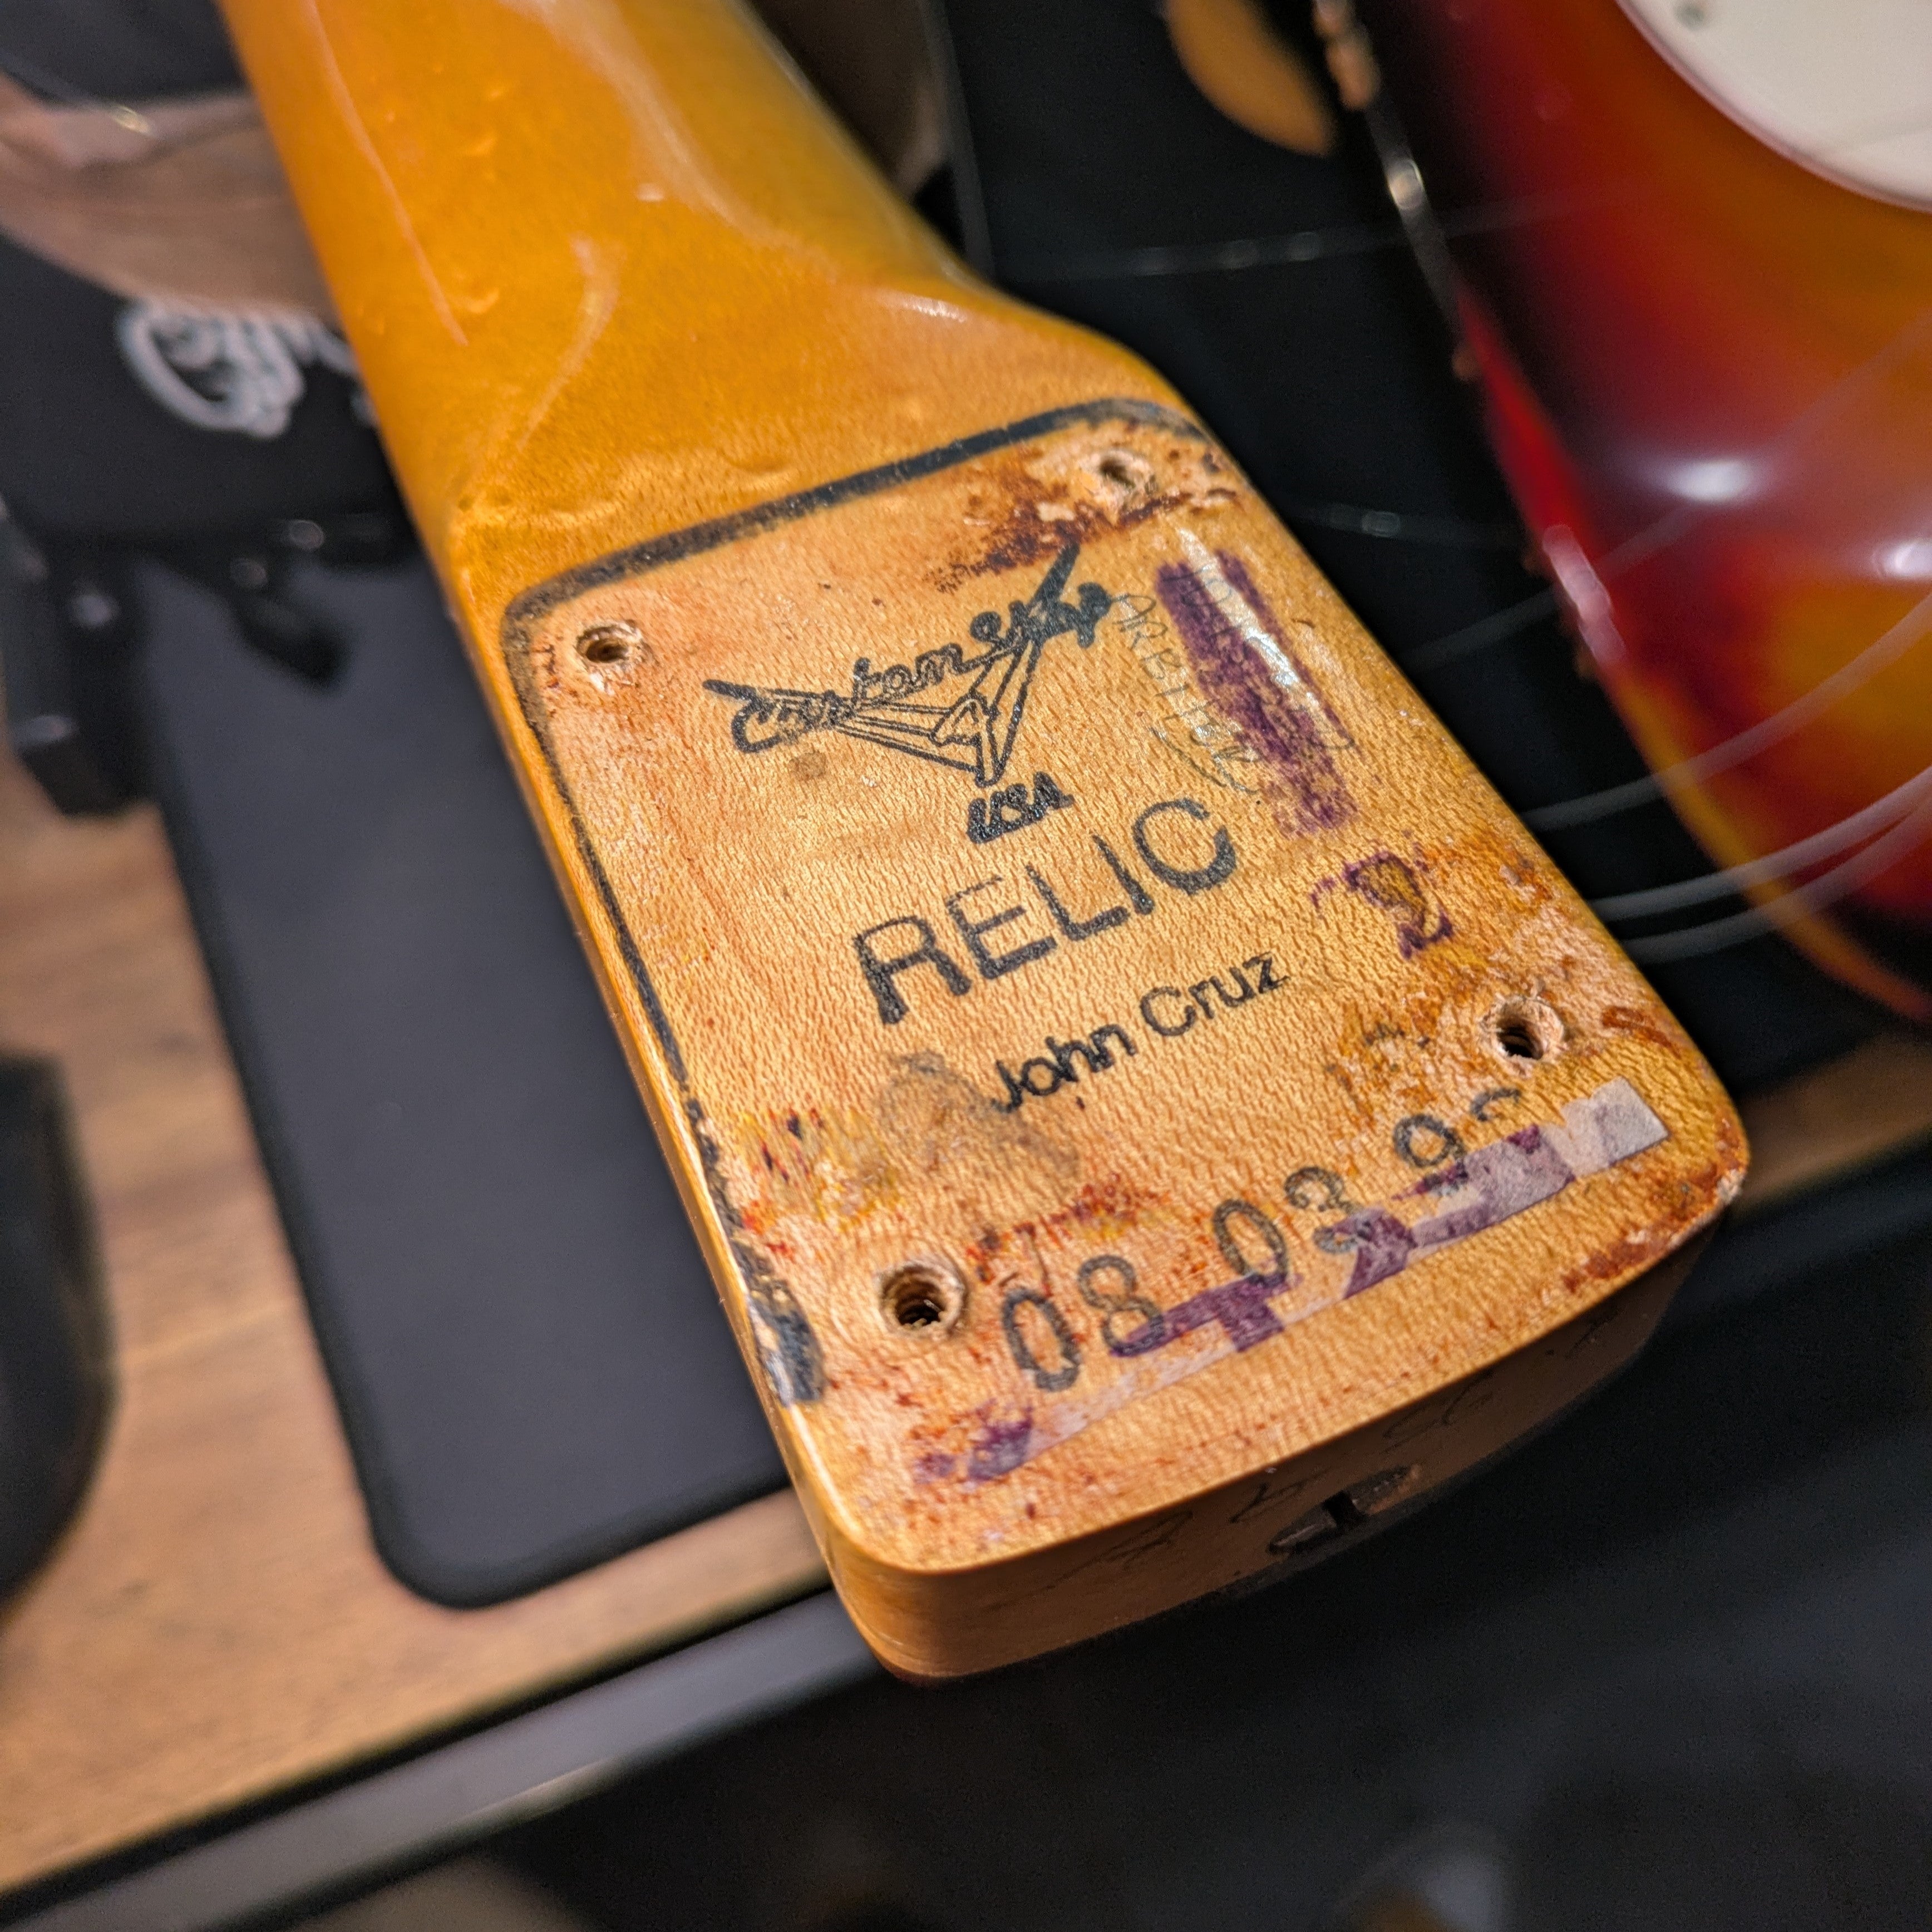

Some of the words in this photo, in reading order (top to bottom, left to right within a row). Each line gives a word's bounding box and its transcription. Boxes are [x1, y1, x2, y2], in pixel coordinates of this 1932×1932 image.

[967, 772, 1076, 844] USA
[852, 797, 1236, 1025] RELIC
[990, 1023, 1138, 1112] John
[1139, 951, 1290, 1037] Cruz
[1000, 1253, 1166, 1392] 08
